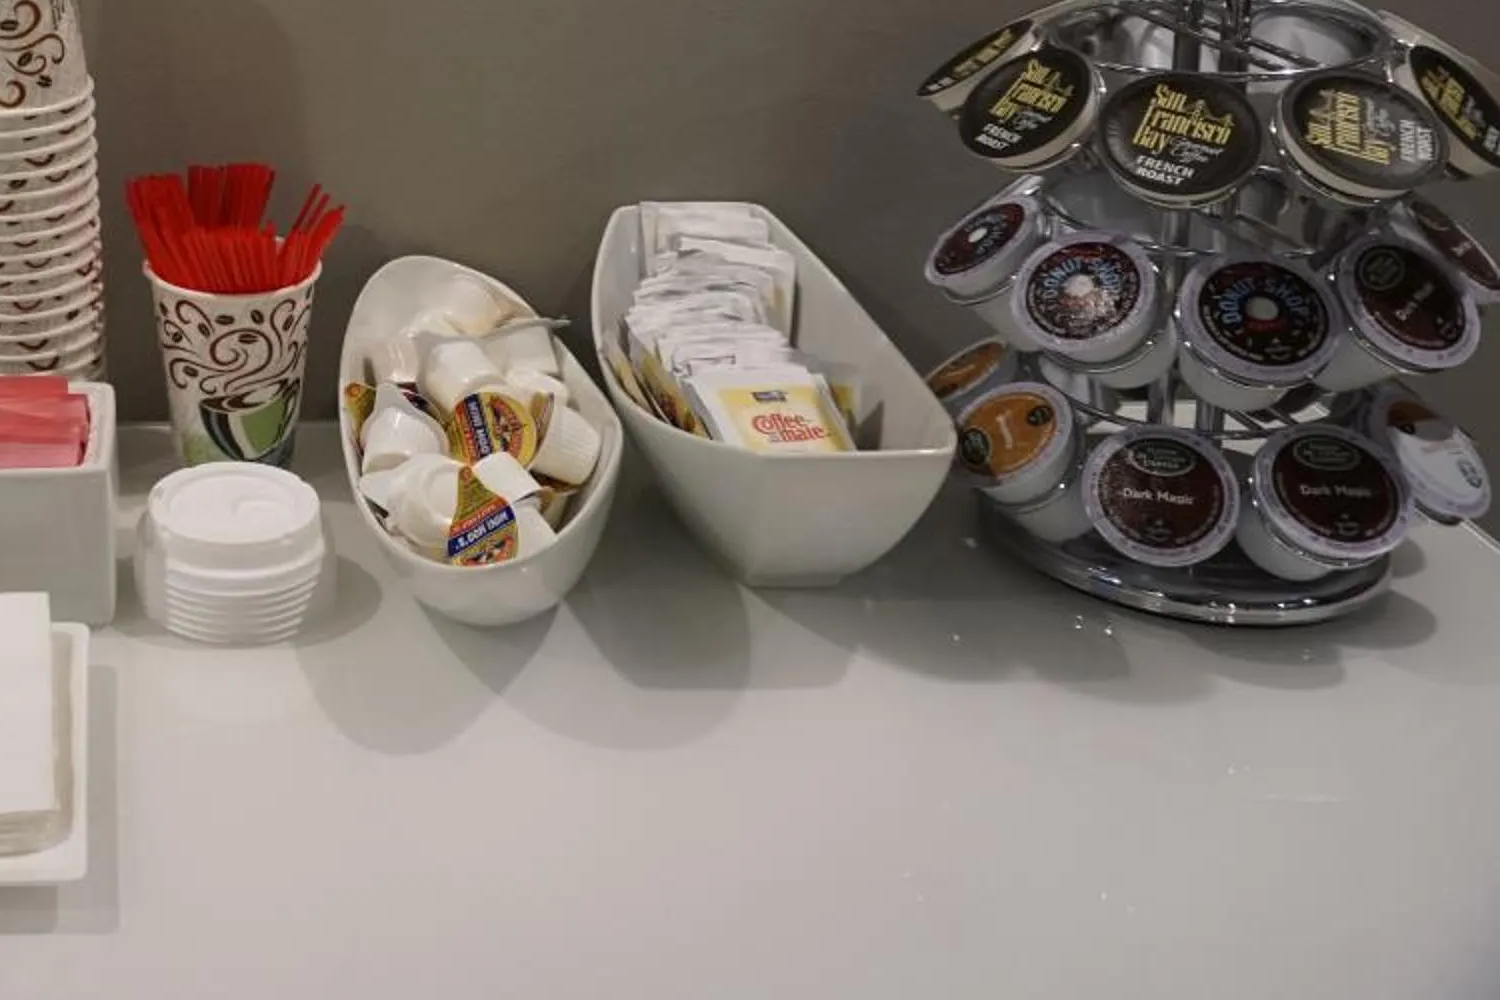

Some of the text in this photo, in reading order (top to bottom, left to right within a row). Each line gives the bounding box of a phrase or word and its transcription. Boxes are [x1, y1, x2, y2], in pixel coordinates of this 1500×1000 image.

[1136, 167, 1185, 186] ROAST
[1137, 154, 1196, 178] FRENCH
[1219, 277, 1257, 325] DONUT
[1123, 487, 1154, 502] Dark
